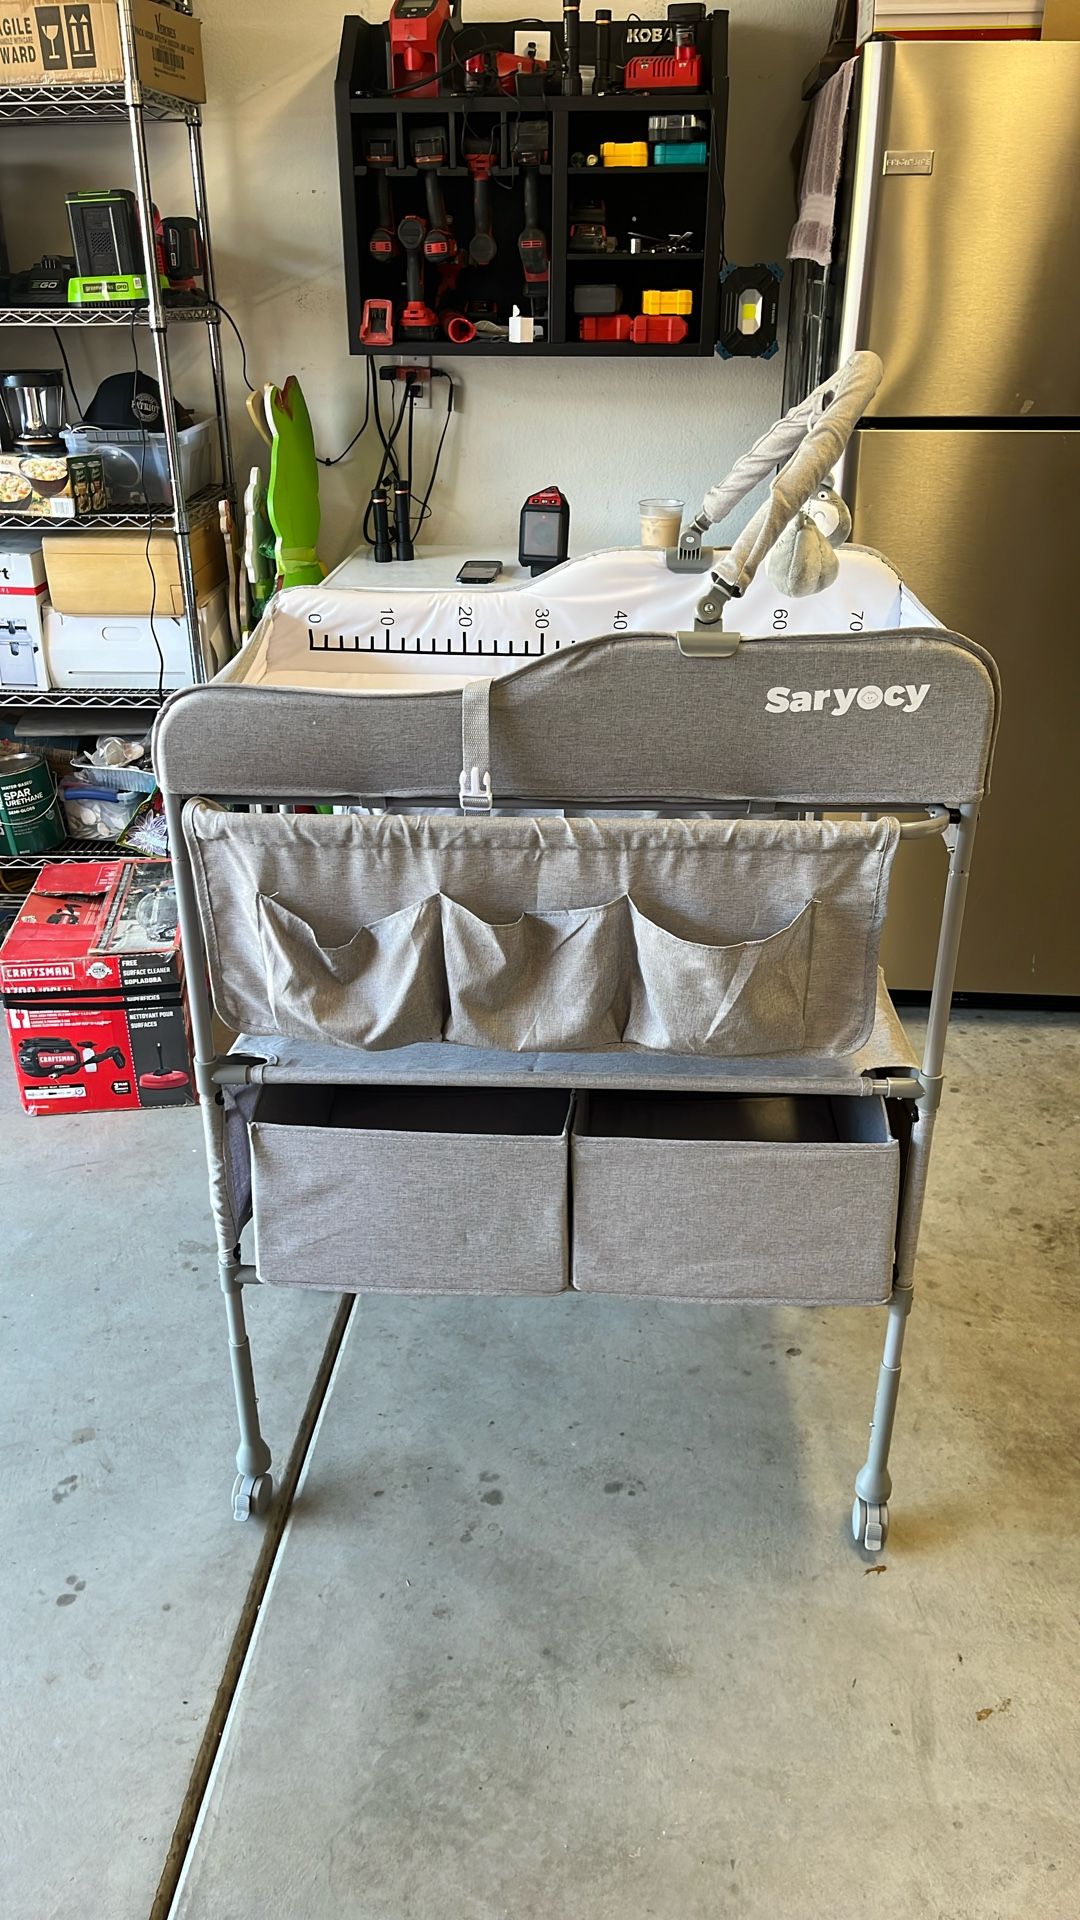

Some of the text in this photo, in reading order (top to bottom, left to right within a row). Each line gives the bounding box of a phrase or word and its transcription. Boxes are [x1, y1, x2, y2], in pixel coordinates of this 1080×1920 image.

[626, 27, 673, 43] KOBA
[308, 613, 322, 624] 0
[380, 608, 395, 626] 10
[458, 606, 473, 627] 20
[535, 608, 550, 629] 30
[613, 610, 628, 630] 40
[772, 609, 789, 630] 60
[849, 611, 864, 632] 70
[764, 684, 931, 716] Saryocy
[3, 787, 31, 801] SPAR
[5, 791, 44, 807] URETHANE
[6, 966, 70, 978] CRAFTSMAN
